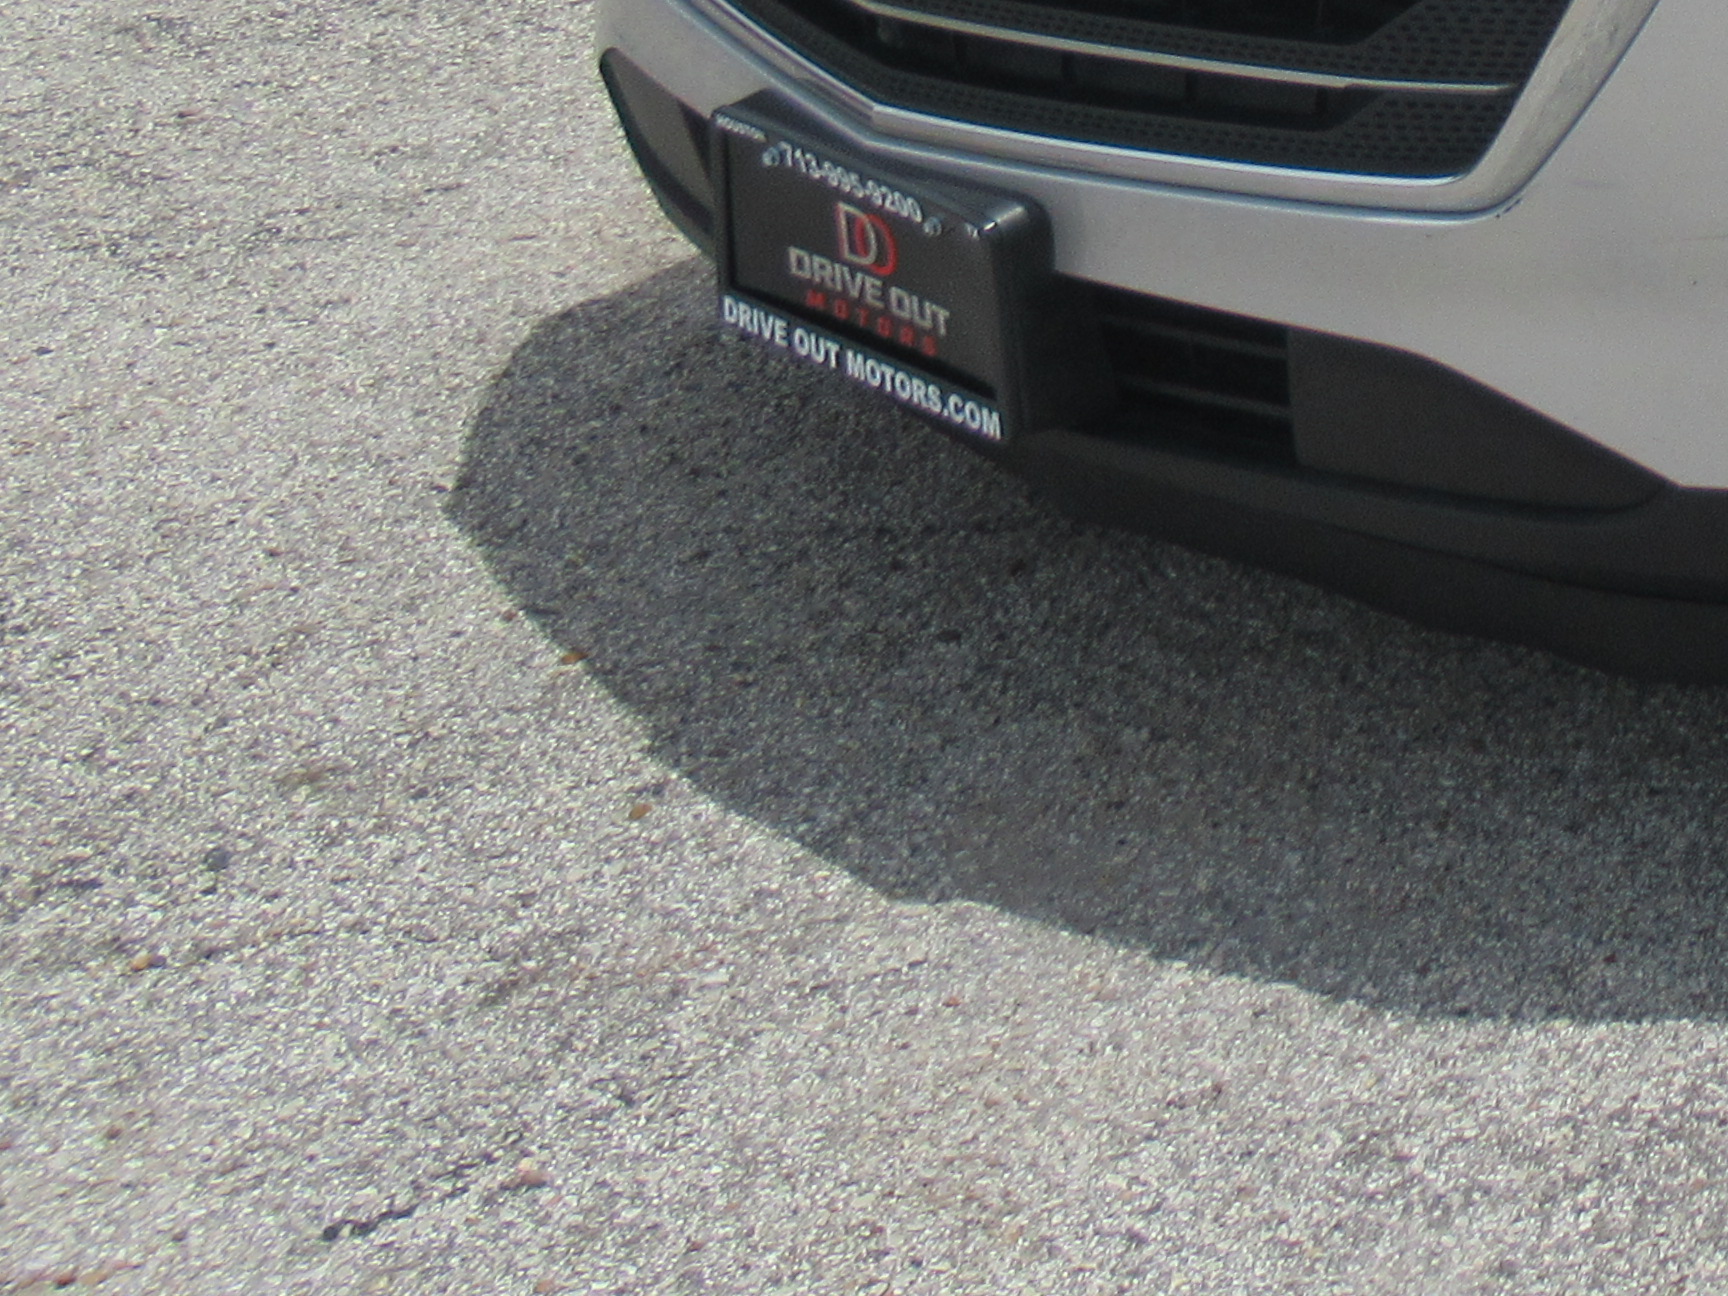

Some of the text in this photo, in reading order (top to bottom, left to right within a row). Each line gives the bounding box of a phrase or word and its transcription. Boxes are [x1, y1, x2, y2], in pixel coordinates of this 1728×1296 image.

[788, 246, 950, 336] DRIVE OUT
[804, 288, 939, 358] MOTORS
[723, 294, 1001, 441] DRIVE OUT MOTORS.COM
